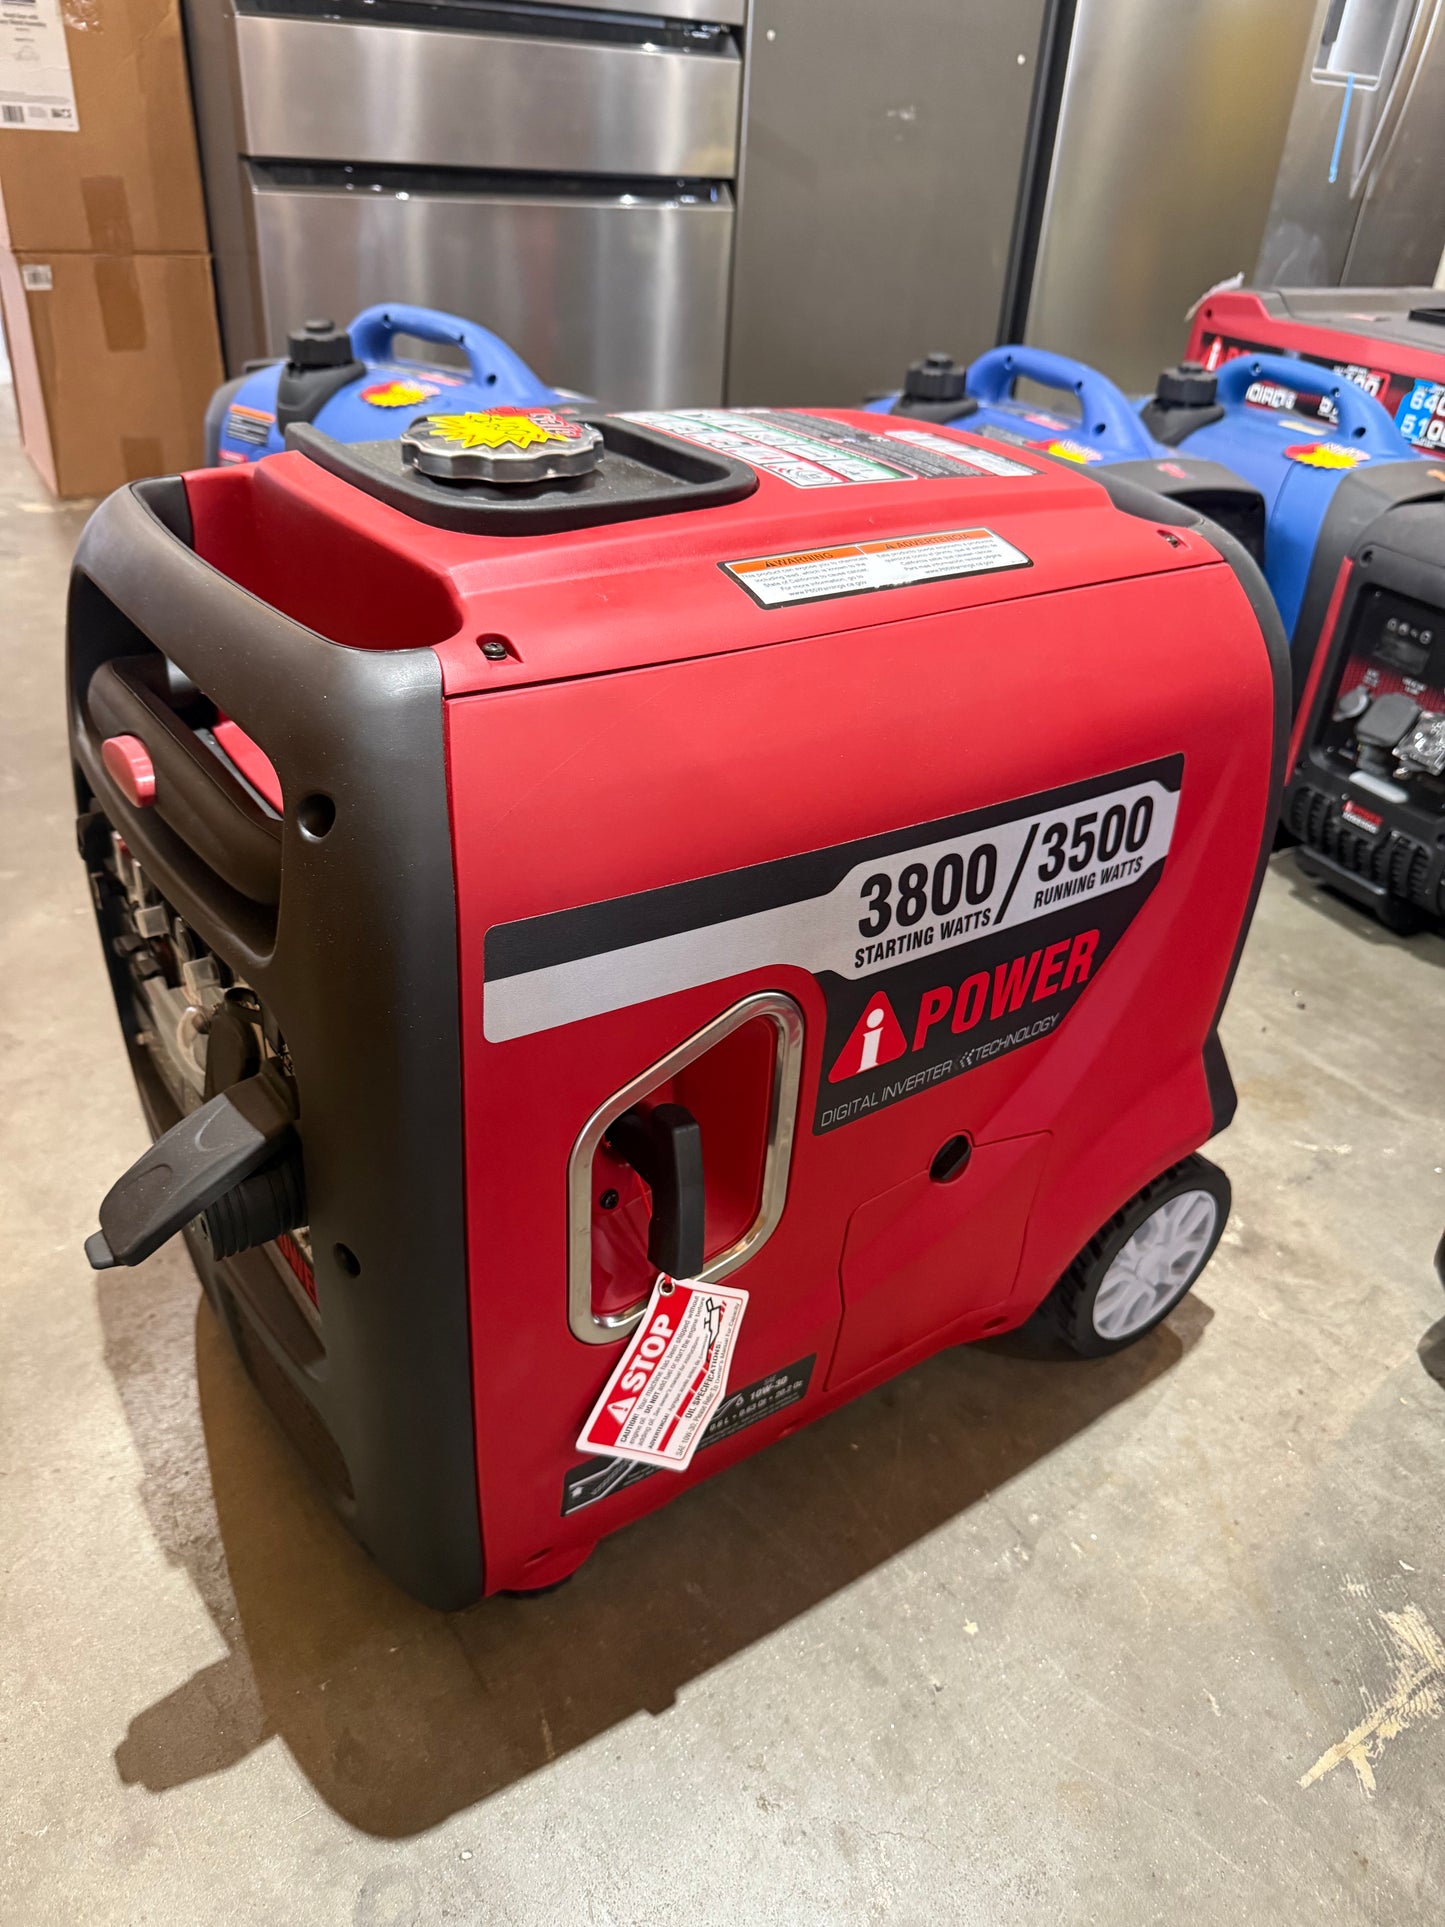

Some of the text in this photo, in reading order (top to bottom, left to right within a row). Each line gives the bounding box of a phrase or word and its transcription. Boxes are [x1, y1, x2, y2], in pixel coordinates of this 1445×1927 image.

[896, 533, 969, 548] ADVERTENCIA
[772, 552, 834, 567] WARNING
[1034, 856, 1143, 909] RUNNING WATTS
[854, 908, 992, 969] STARTING WATTS
[912, 929, 1100, 1053] POWER
[820, 1012, 1060, 1127] DIGITAL INVERTER TECHNOLOGY
[620, 1313, 675, 1394] STOP
[649, 1391, 660, 1403] NOT
[750, 1375, 788, 1401] 10W-30
[684, 1406, 696, 1418] OIL
[619, 1413, 639, 1442] CAUTION!
